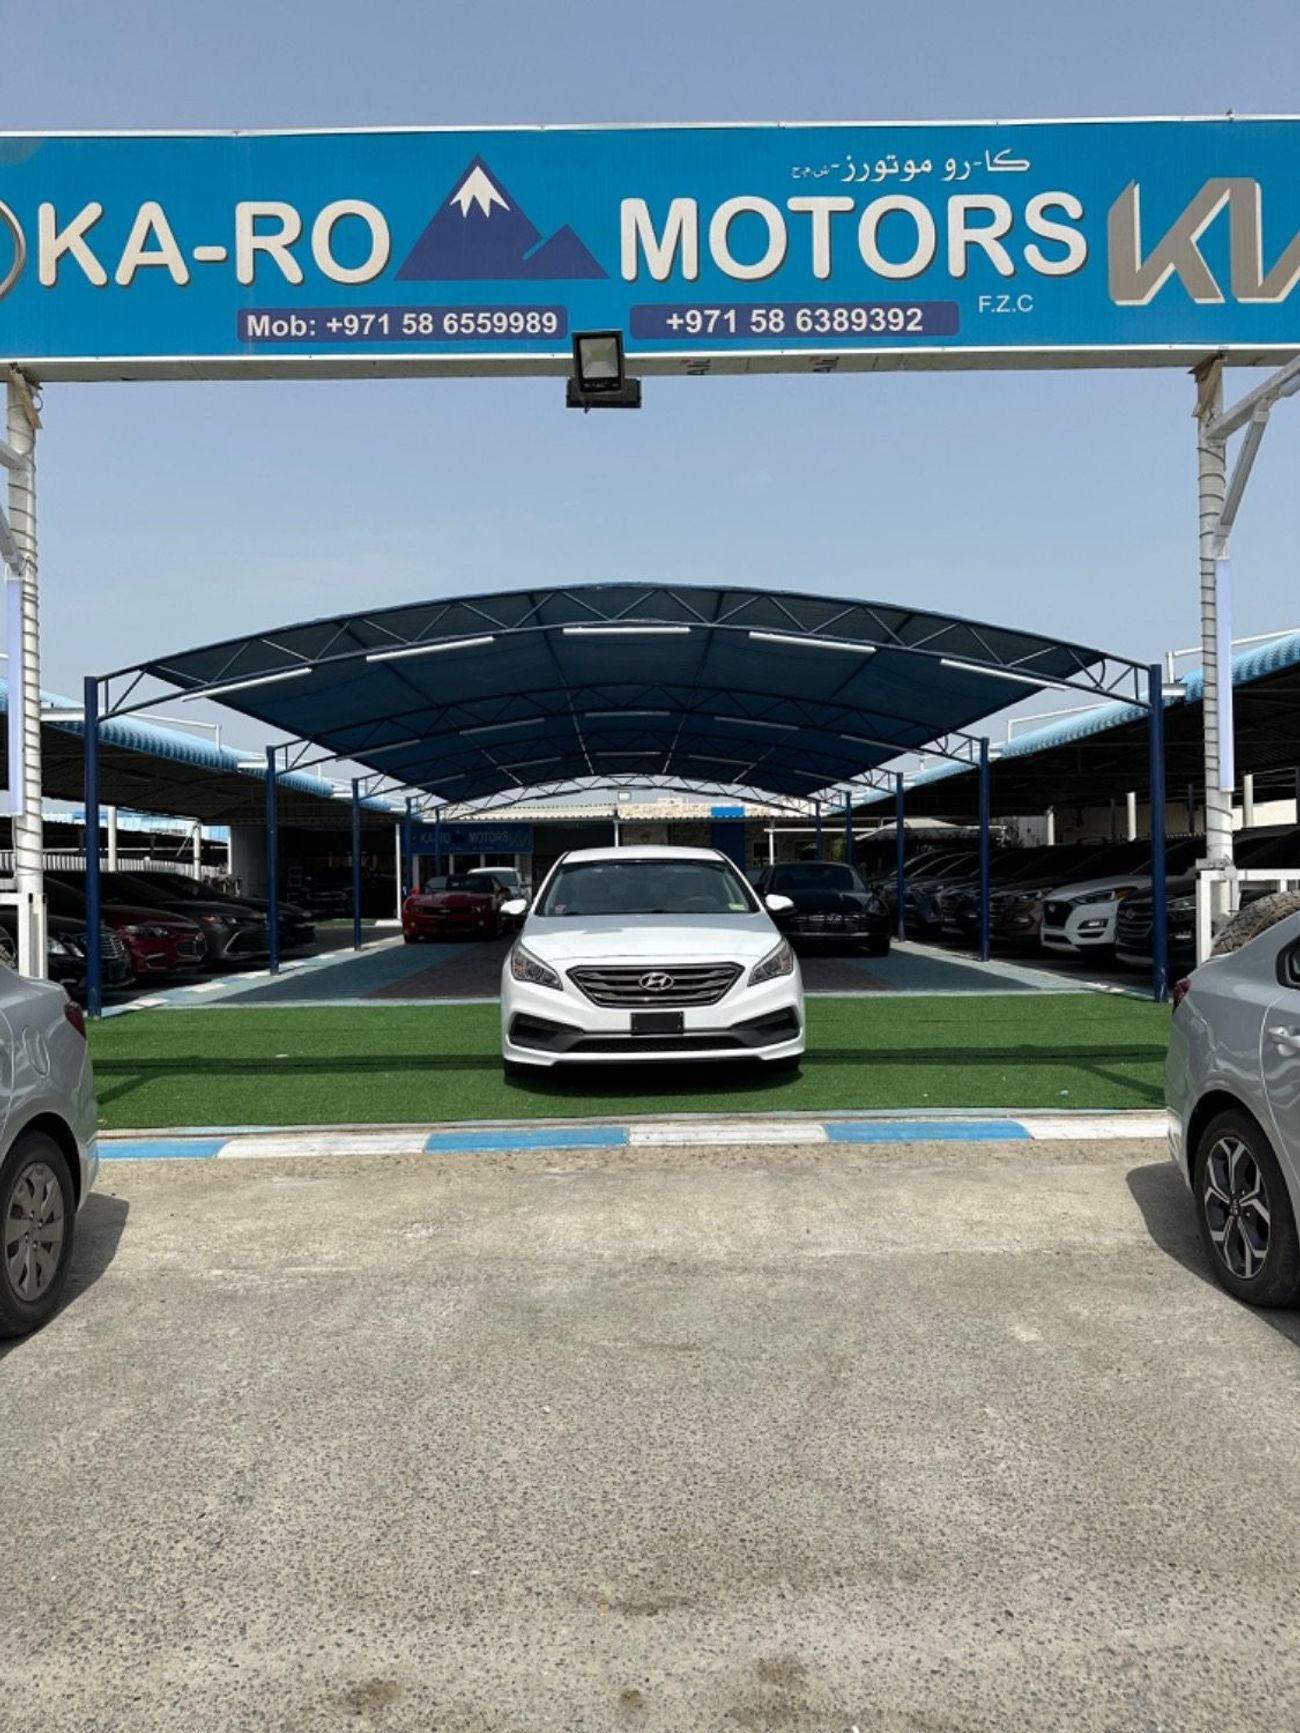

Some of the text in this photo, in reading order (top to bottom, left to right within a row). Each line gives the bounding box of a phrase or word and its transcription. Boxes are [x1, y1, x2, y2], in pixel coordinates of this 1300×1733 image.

[38, 192, 1089, 287] KA-RO MOTORS
[978, 294, 1034, 314] F.Z.C
[247, 311, 558, 337] Mob: +971 58 6559989
[666, 306, 924, 333] +971 58 6389392
